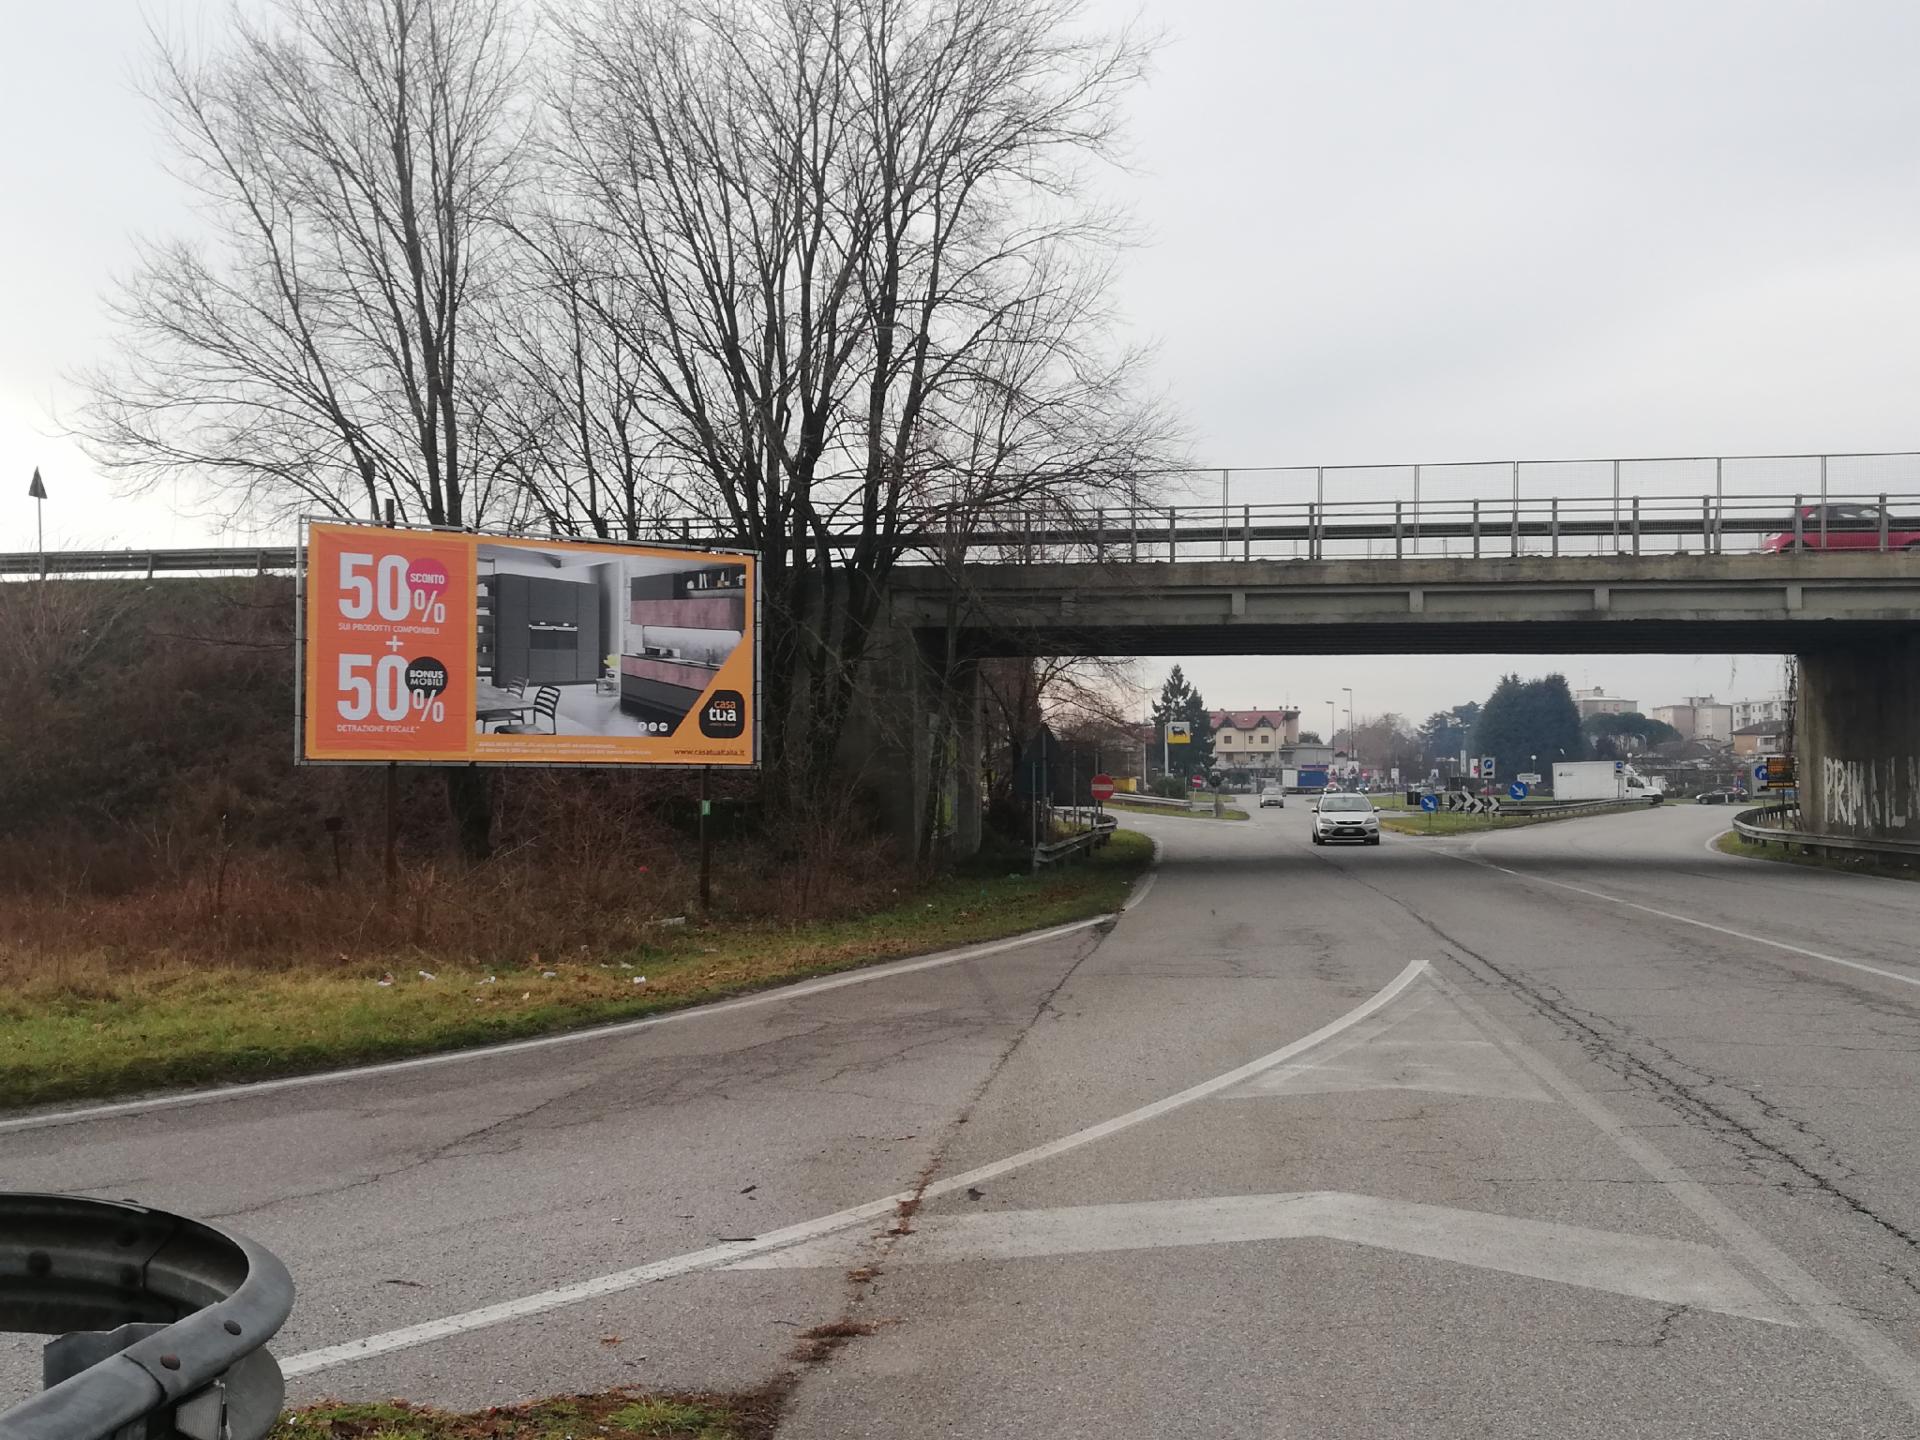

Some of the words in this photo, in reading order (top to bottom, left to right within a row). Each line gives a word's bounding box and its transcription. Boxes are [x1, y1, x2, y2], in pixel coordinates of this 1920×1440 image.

[410, 573, 445, 584] SCONTO
[338, 623, 351, 632] SUI
[352, 624, 391, 633] PRODOTTI
[409, 670, 444, 679] BONUS
[410, 678, 444, 686] MOBILI
[714, 700, 736, 709] casa
[708, 707, 737, 722] tua
[336, 724, 384, 733] DETRAZIONE
